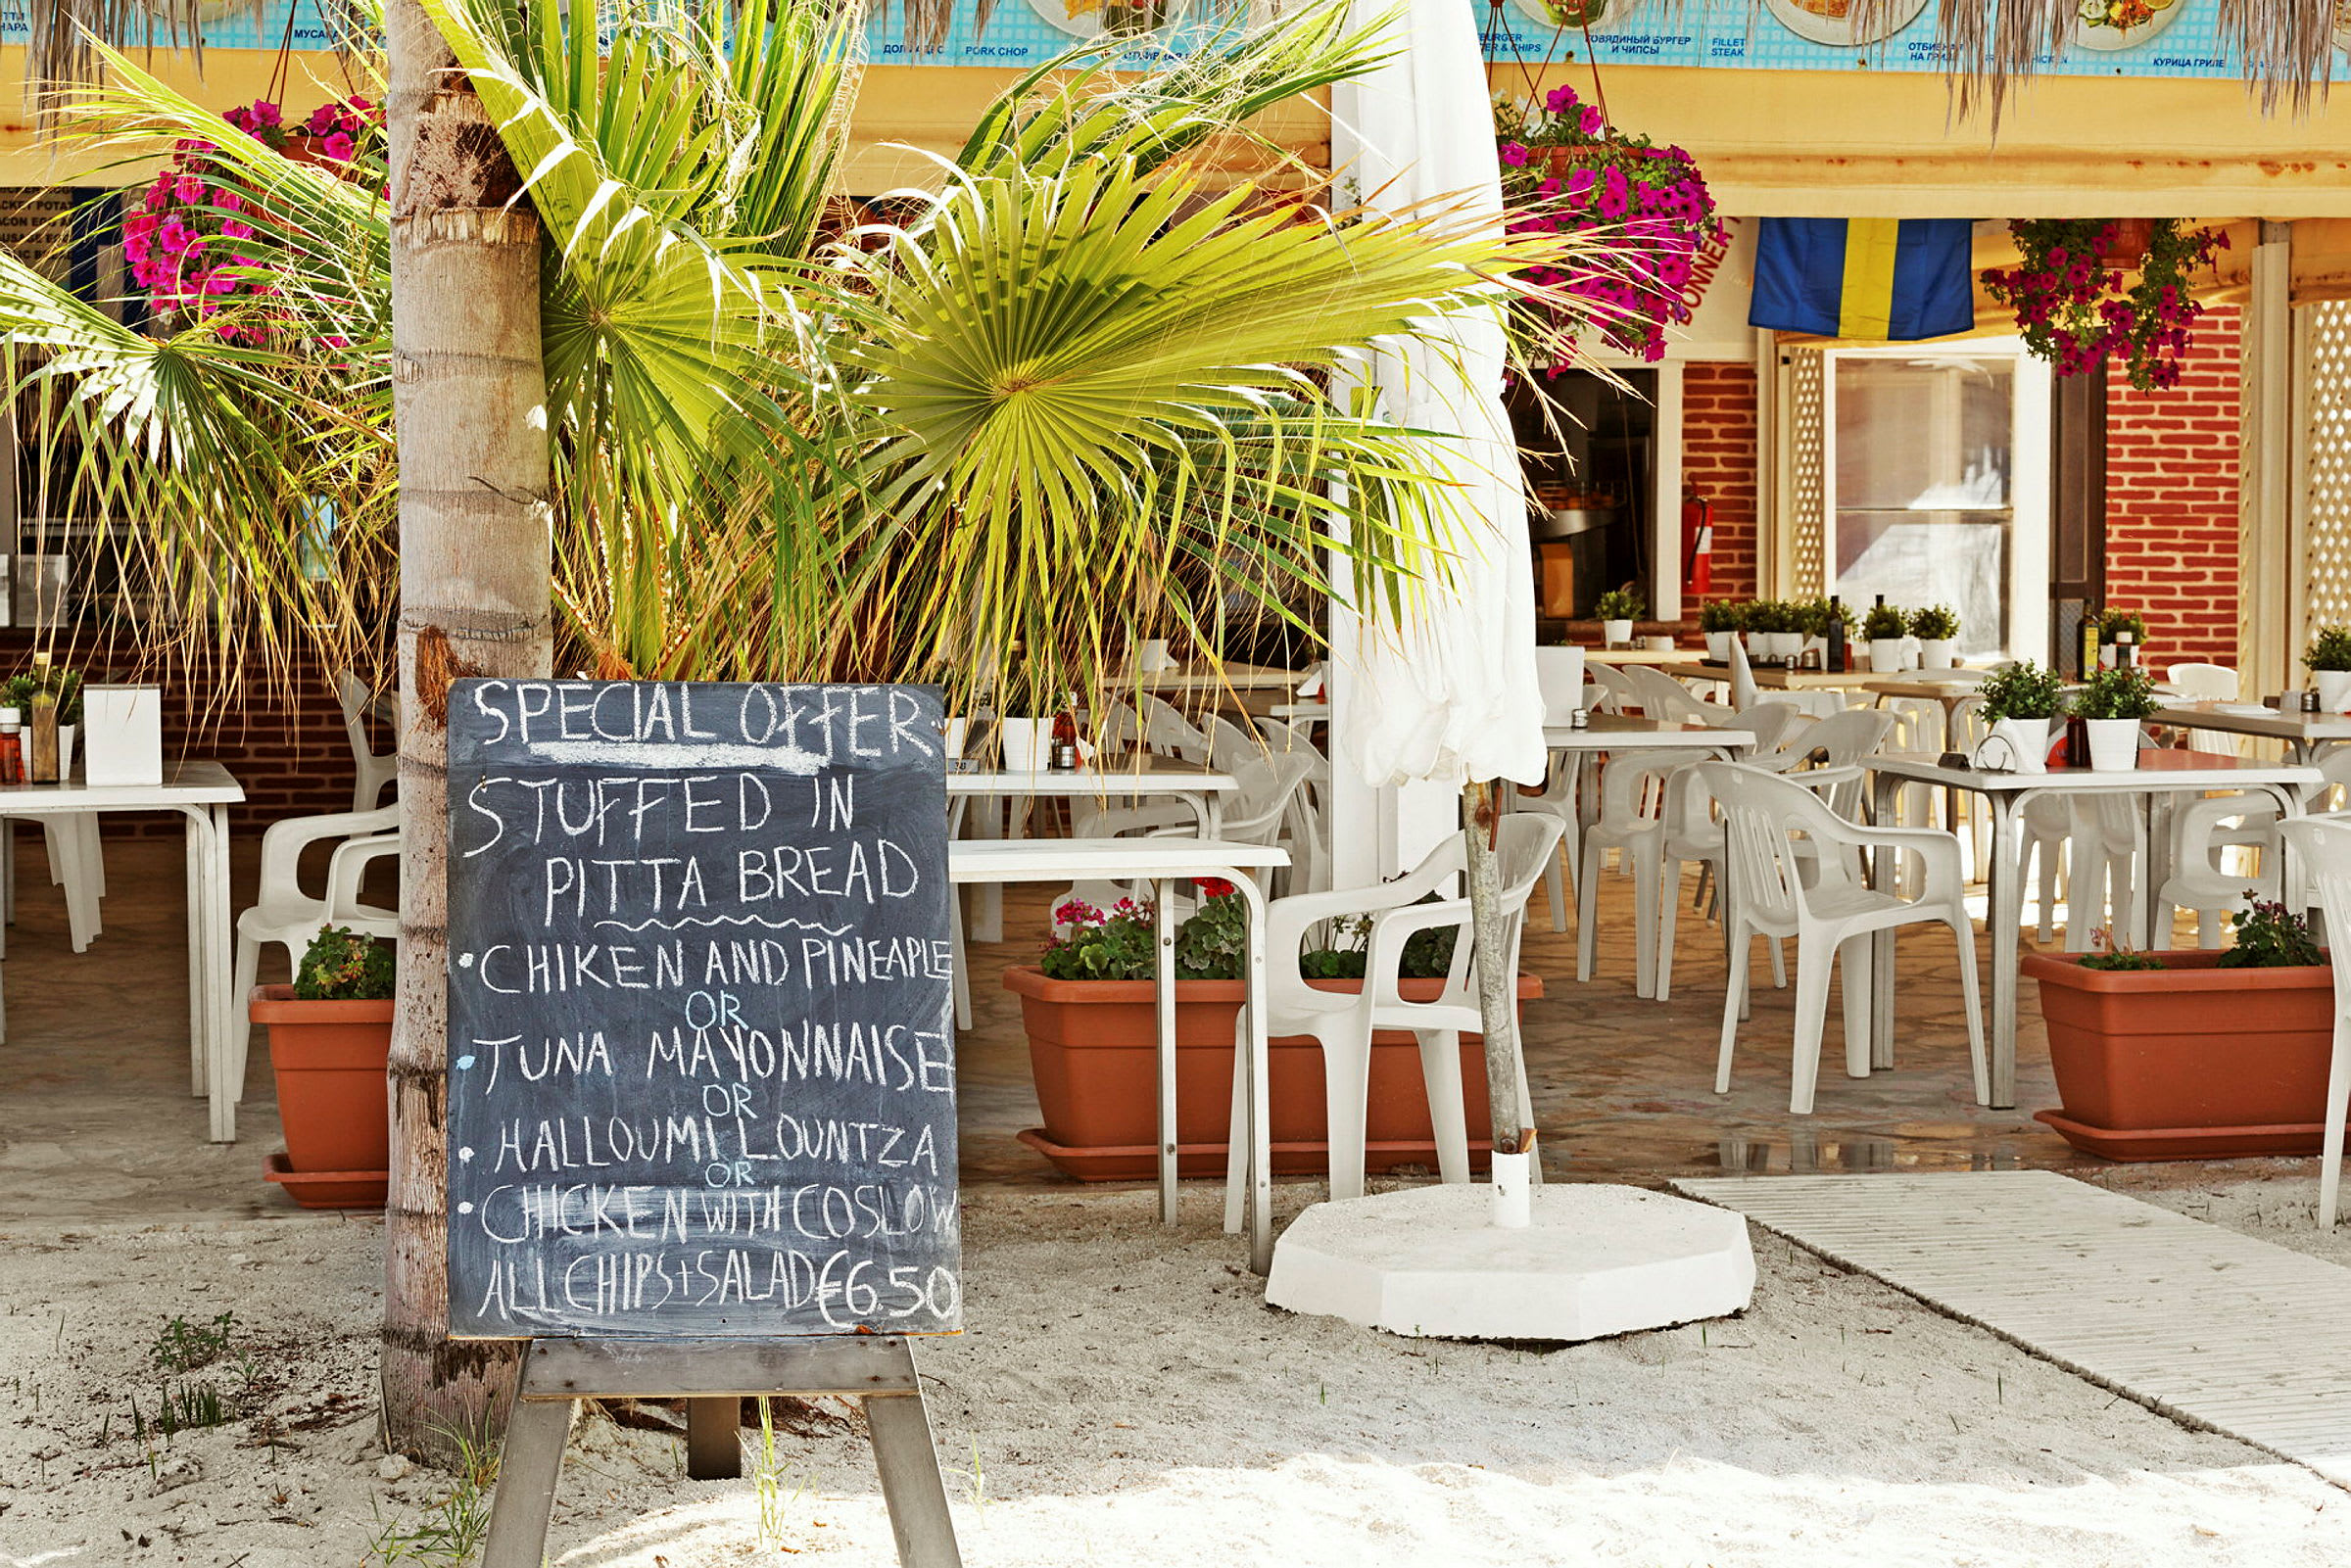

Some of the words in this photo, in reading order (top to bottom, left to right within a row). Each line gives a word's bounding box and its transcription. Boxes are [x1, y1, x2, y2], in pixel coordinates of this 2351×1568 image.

[294, 29, 340, 39] МУСАА
[965, 46, 996, 56] PORK
[997, 47, 1029, 57] CHOP
[1611, 45, 1619, 54] И
[1621, 45, 1659, 55] ЧИПСЫ
[1653, 36, 1692, 45] БУРГЕР
[1711, 37, 1746, 47] FILLET
[1710, 48, 1745, 57] STEAK
[1910, 52, 1924, 61] НА
[2153, 58, 2191, 68] КУРИЦА
[475, 680, 716, 744] SPECIAL
[740, 682, 934, 759] OFFER
[462, 773, 772, 858] STUFFED
[811, 773, 853, 832] IN
[545, 855, 707, 927] PITTA
[739, 839, 920, 904] BREAD
[480, 939, 686, 993] CHIKEN
[704, 940, 790, 985] AND
[801, 937, 954, 989] PINEAPLE
[686, 990, 749, 1031] OR
[471, 1030, 613, 1095] TUNA
[647, 1019, 956, 1093] MAYONNAISE
[702, 1083, 758, 1118] OR
[494, 1114, 719, 1174] HALLOUMI
[737, 1113, 939, 1176] LOUNTZA
[704, 1162, 755, 1188] OR
[481, 1183, 688, 1245] CHICKEN
[700, 1185, 783, 1238] WITH
[793, 1183, 957, 1240] COSLOW
[476, 1259, 561, 1320] ALL
[564, 1252, 674, 1315] CHIPS
[696, 1249, 815, 1309] SALAD
